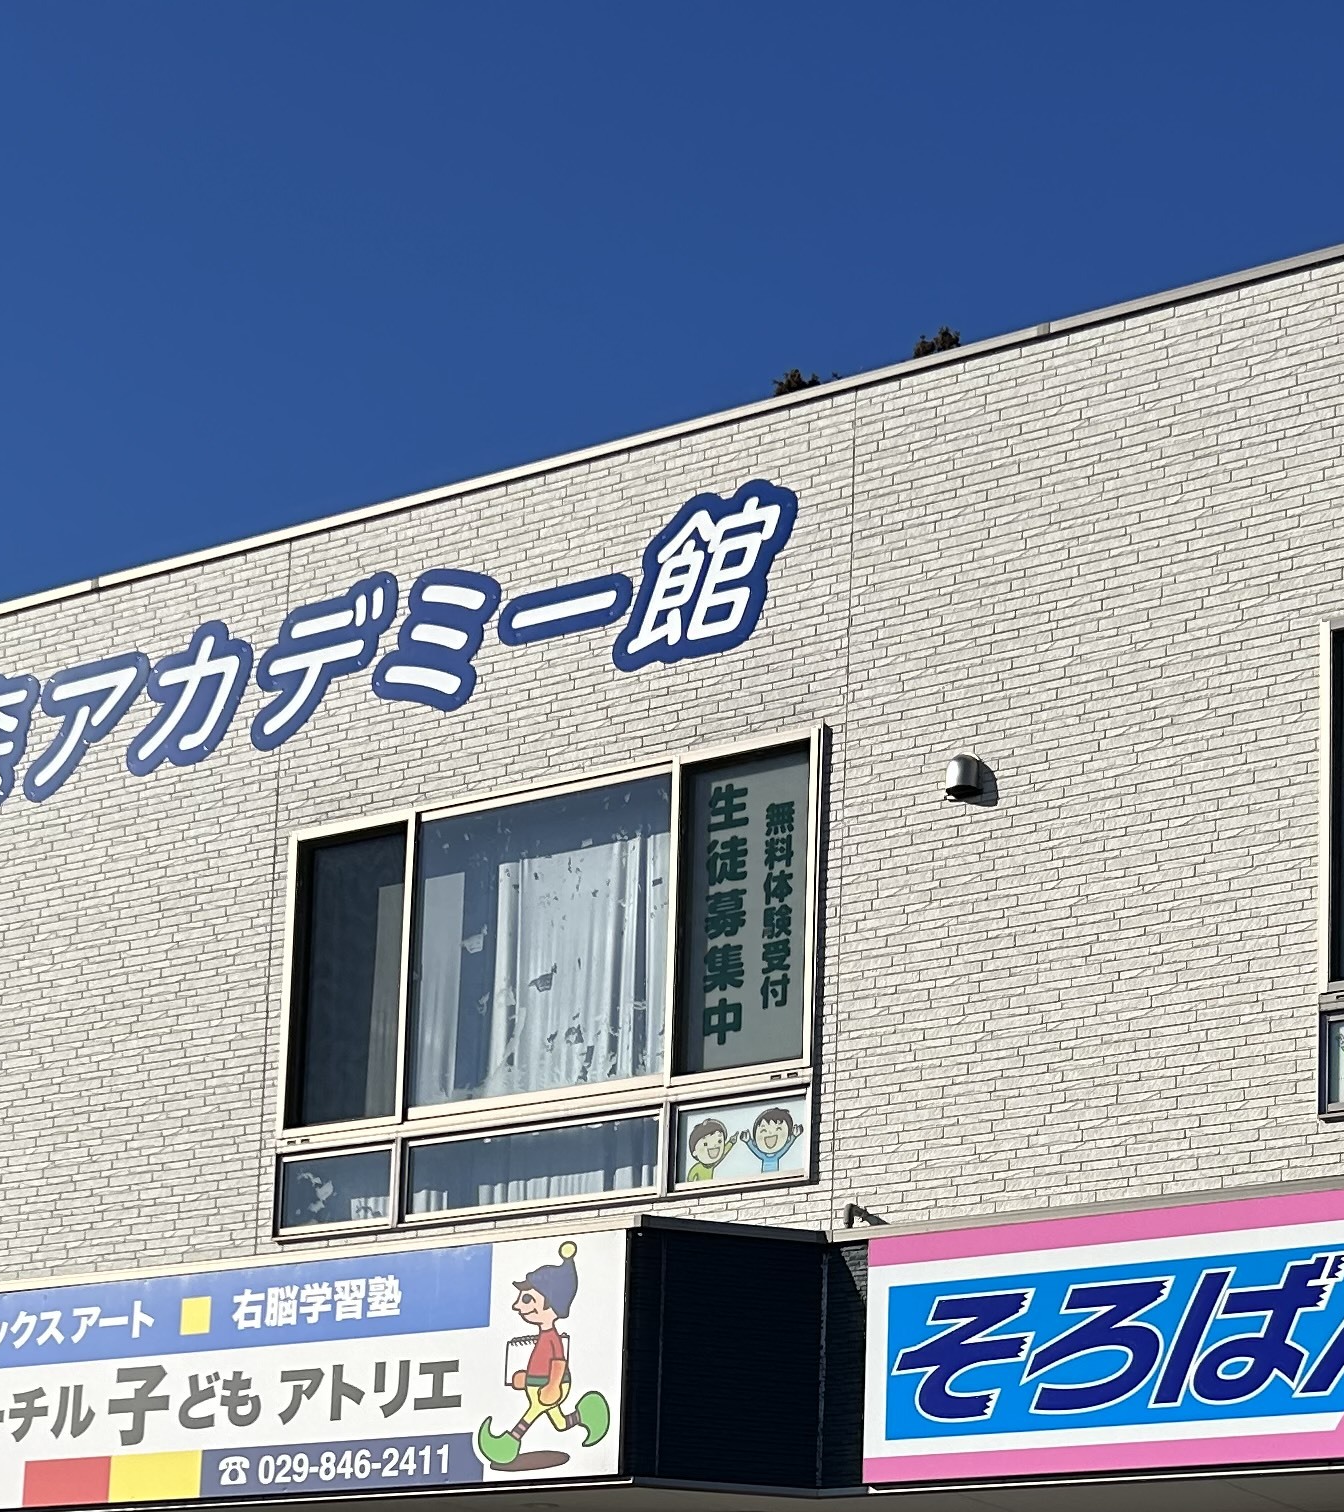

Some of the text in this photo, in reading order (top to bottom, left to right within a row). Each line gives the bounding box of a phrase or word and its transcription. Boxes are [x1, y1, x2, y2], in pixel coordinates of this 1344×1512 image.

[702, 783, 749, 1046] 生徒募集中
[760, 802, 795, 1010] 無料体験受付
[231, 1275, 404, 1331] 右脳学習塾
[258, 1444, 450, 1485] 029-846-2411
